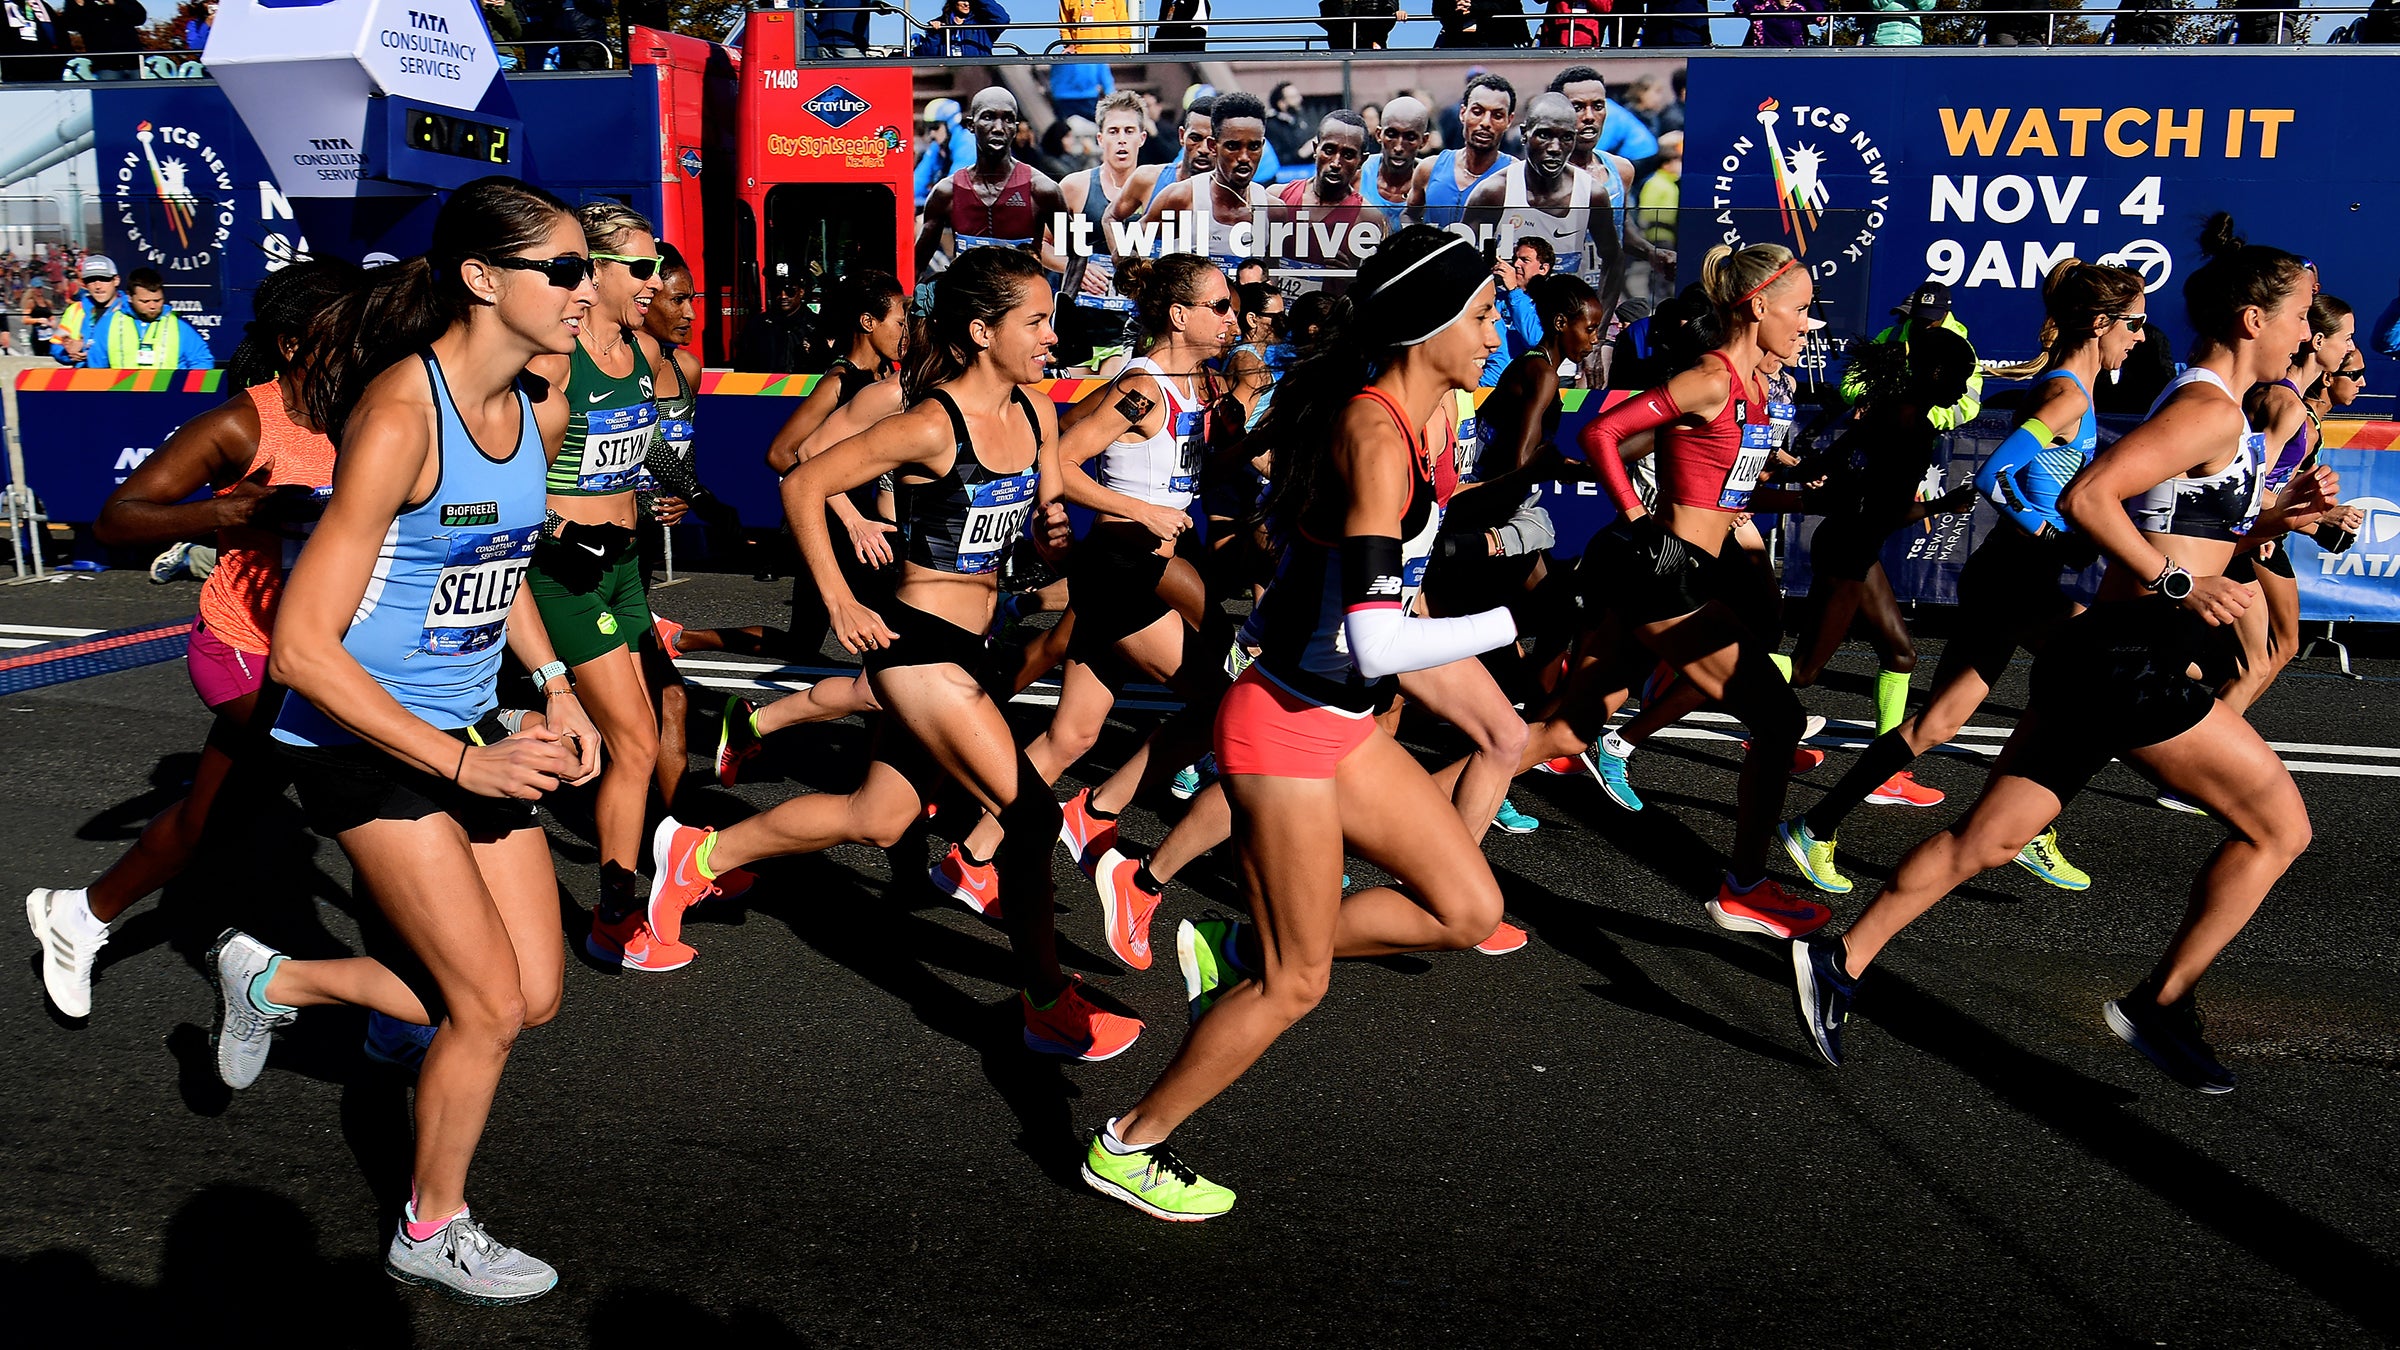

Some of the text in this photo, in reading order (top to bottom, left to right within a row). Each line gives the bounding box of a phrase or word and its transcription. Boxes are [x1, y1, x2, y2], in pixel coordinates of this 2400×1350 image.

[408, 10, 449, 35] TATA
[381, 30, 476, 62] CONSULTANCY
[400, 56, 461, 80] SERVICES
[763, 69, 798, 89] 71408
[159, 126, 201, 149] TCS
[308, 138, 354, 150] TATA
[1938, 107, 2295, 159] WATCH IT
[768, 134, 888, 158] City Sightseeing
[201, 146, 234, 190] NEW
[293, 153, 369, 166] CONSULTAN
[317, 168, 369, 181] SERVICE
[1713, 106, 1889, 280] TCS NEW YORK CI RATHON
[1929, 174, 2165, 225] NOV. 4
[116, 151, 166, 264] MARATHON
[210, 199, 236, 252] YORK
[1054, 211, 1094, 257] It
[1110, 210, 1209, 257] will
[1229, 210, 1382, 258] drive
[1524, 220, 1535, 228] NN
[170, 252, 212, 270] CITY
[1924, 238, 2076, 289] 9AM
[169, 301, 203, 312] TATA
[1103, 300, 1125, 309] 2017
[595, 432, 648, 468] STEYN
[969, 502, 1031, 545] BLUSK
[1922, 512, 1955, 560] NEW YO
[475, 540, 519, 554] CONSULTANCY
[492, 534, 510, 544] TATA
[1906, 537, 1926, 560] TCS
[2317, 552, 2400, 578] TATA
[2031, 841, 2055, 871] HOKA
